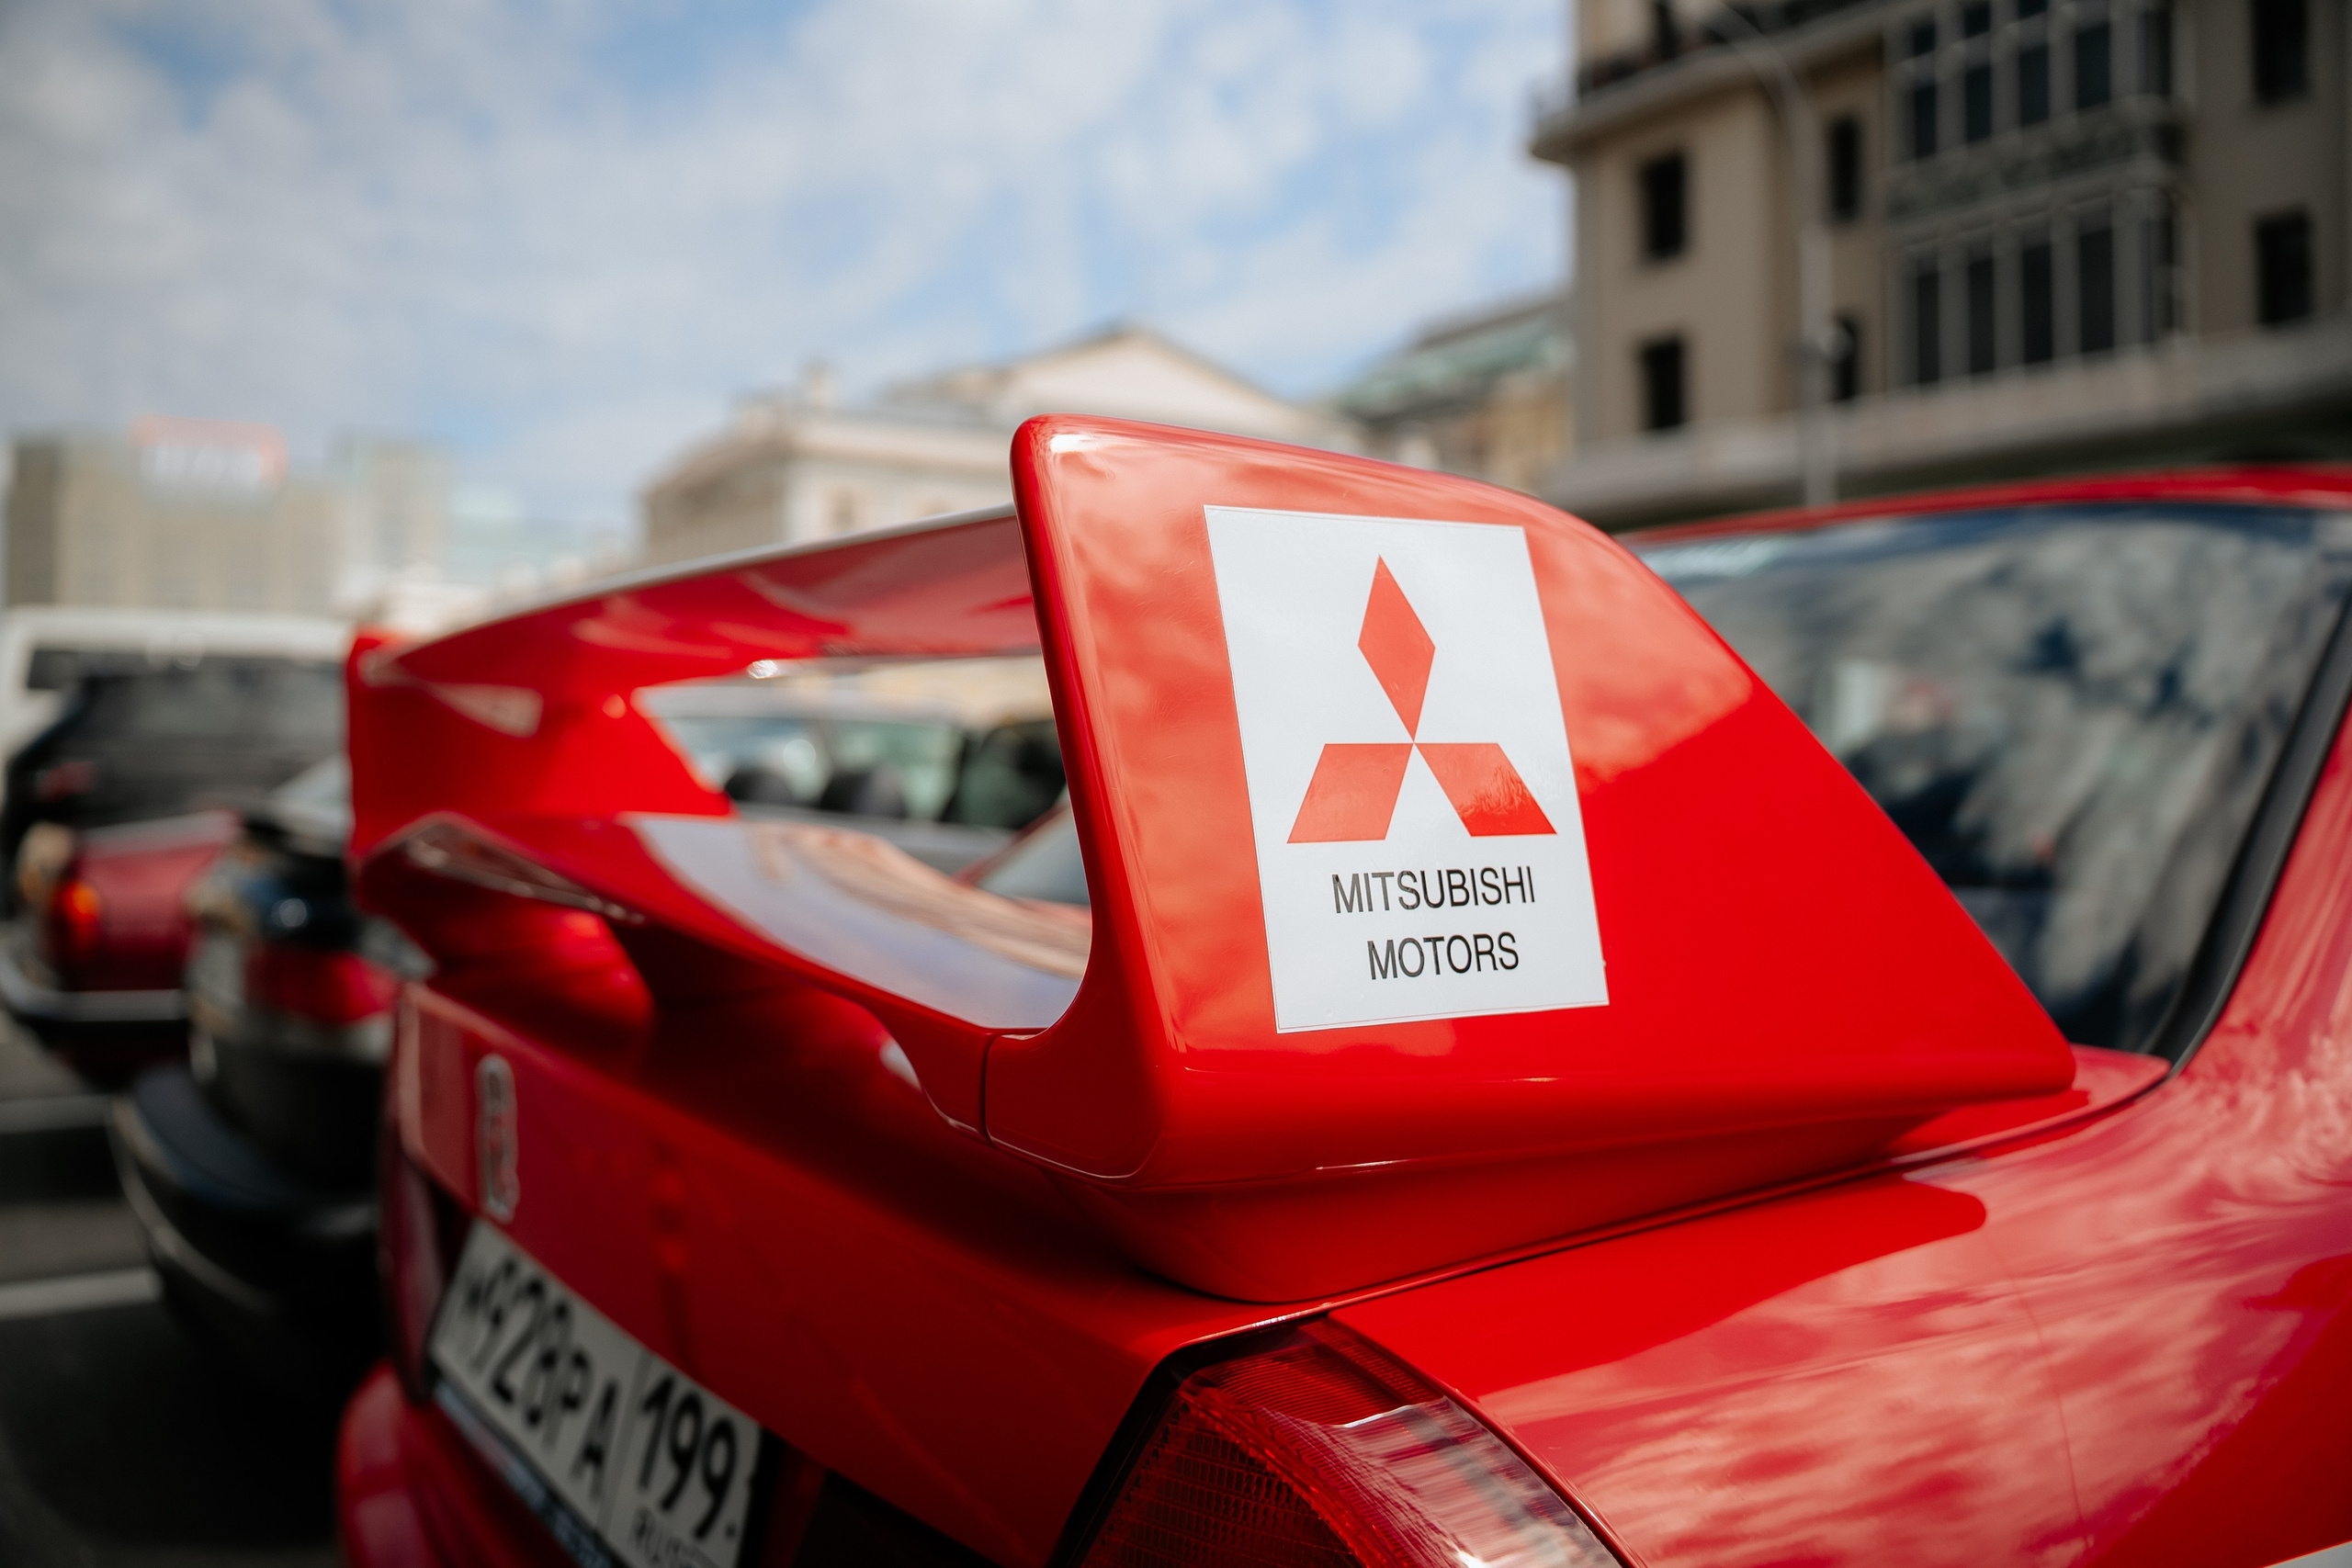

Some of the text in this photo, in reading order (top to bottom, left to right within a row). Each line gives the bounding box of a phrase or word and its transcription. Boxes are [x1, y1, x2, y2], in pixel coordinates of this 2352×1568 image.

[1332, 865, 1535, 914] MITSUBISHI
[1367, 931, 1520, 980] MOTORS
[640, 1374, 737, 1540] 199
